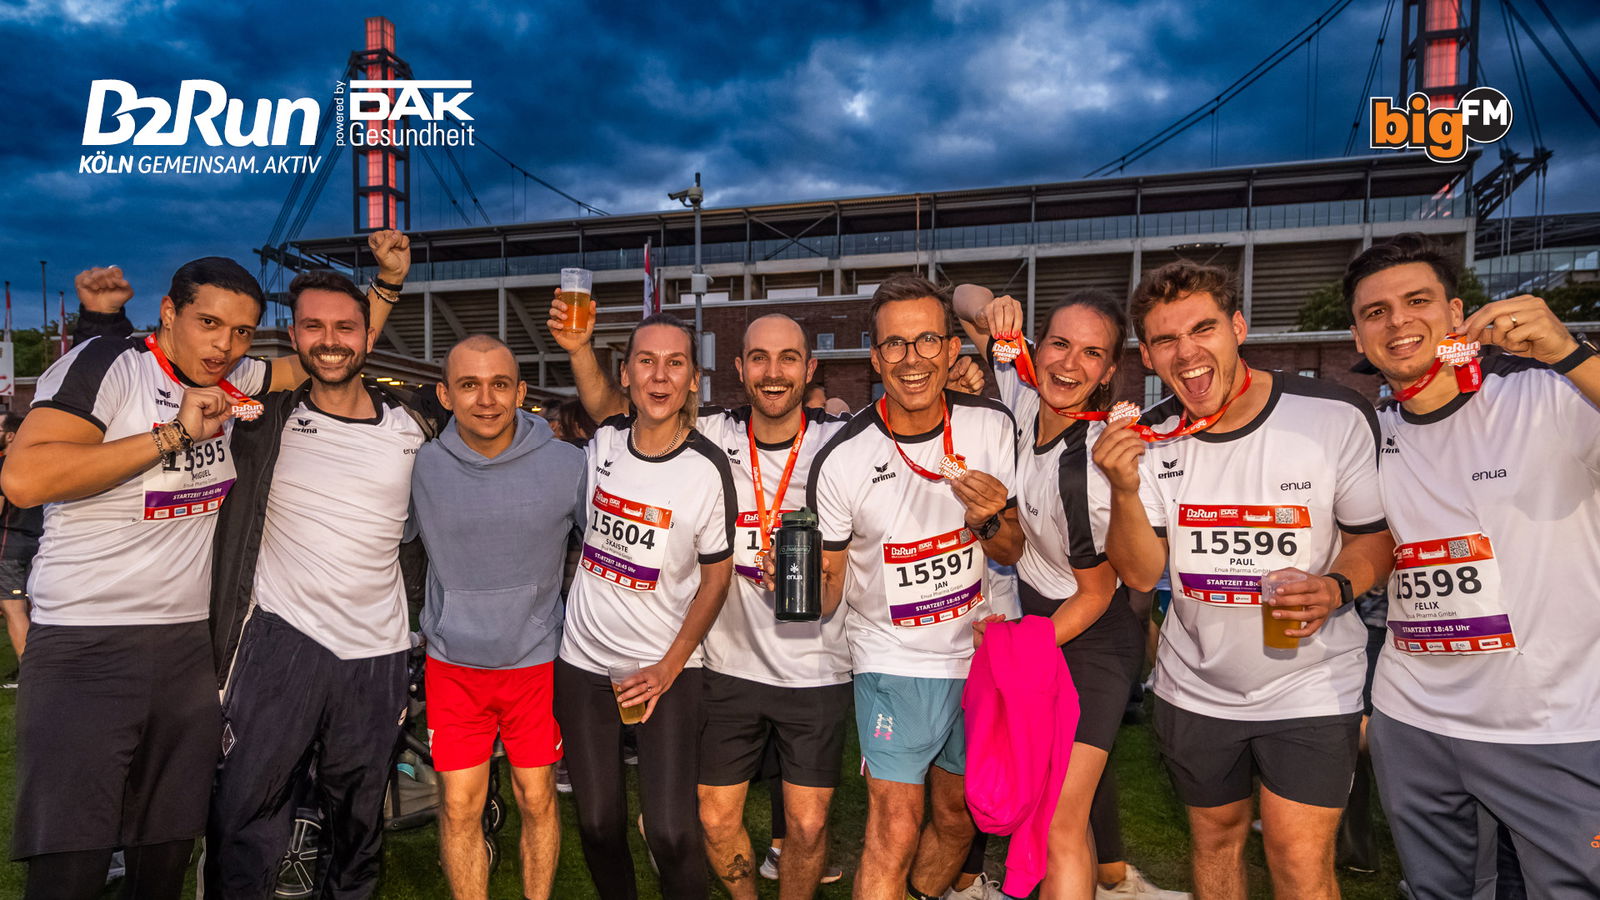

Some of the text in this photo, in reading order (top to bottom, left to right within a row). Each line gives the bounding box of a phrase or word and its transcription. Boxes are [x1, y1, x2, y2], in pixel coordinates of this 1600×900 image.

[1437, 342, 1480, 355] B2Run
[192, 470, 211, 480] MIGUEL
[872, 472, 896, 484] erima
[1158, 469, 1184, 480] erima
[1471, 468, 1507, 482] enua
[1280, 481, 1312, 491] enua
[1187, 509, 1217, 518] B2Run
[591, 510, 655, 550] 15604
[606, 538, 628, 553] SKAISTE
[1191, 531, 1297, 556] 15596
[891, 547, 917, 555] B2Run
[1230, 558, 1255, 566] PAUL
[896, 547, 974, 588] 15597
[935, 581, 948, 591] JAN
[915, 601, 945, 611] STARTZEIT
[1415, 601, 1439, 610] FELIX
